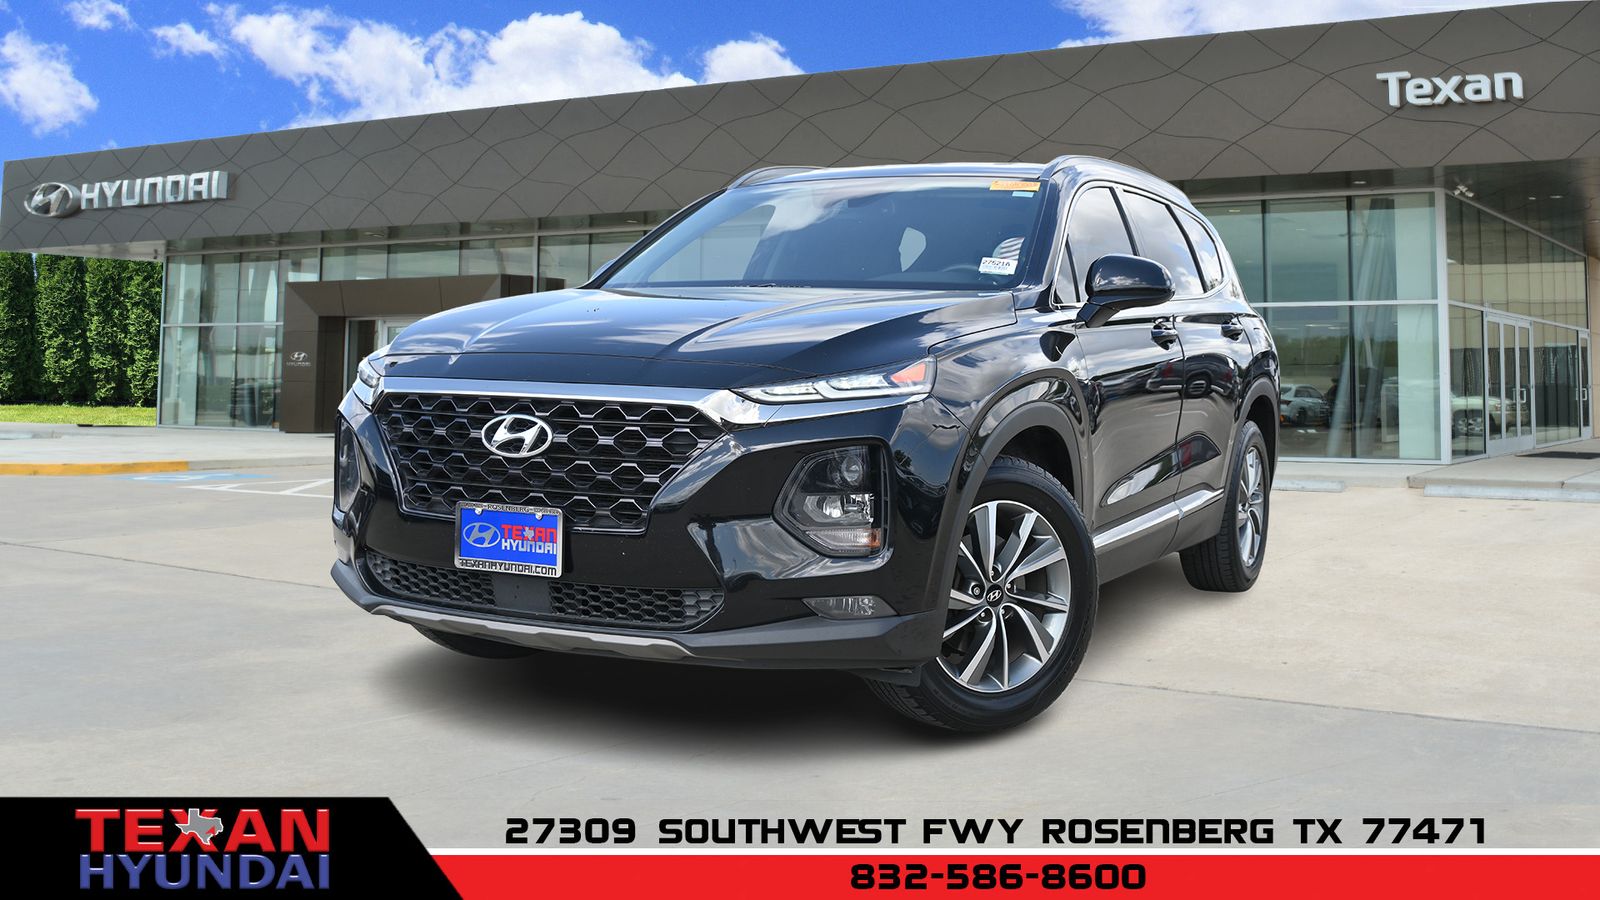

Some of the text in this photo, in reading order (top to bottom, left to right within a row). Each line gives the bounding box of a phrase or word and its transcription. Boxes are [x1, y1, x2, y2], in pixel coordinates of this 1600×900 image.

[1376, 71, 1523, 107] Texan
[81, 171, 227, 209] HYUNDAI
[501, 524, 557, 543] TEXAN
[501, 538, 557, 555] HYUNDAI
[460, 559, 557, 576] TEXANHYUNDAI.COM
